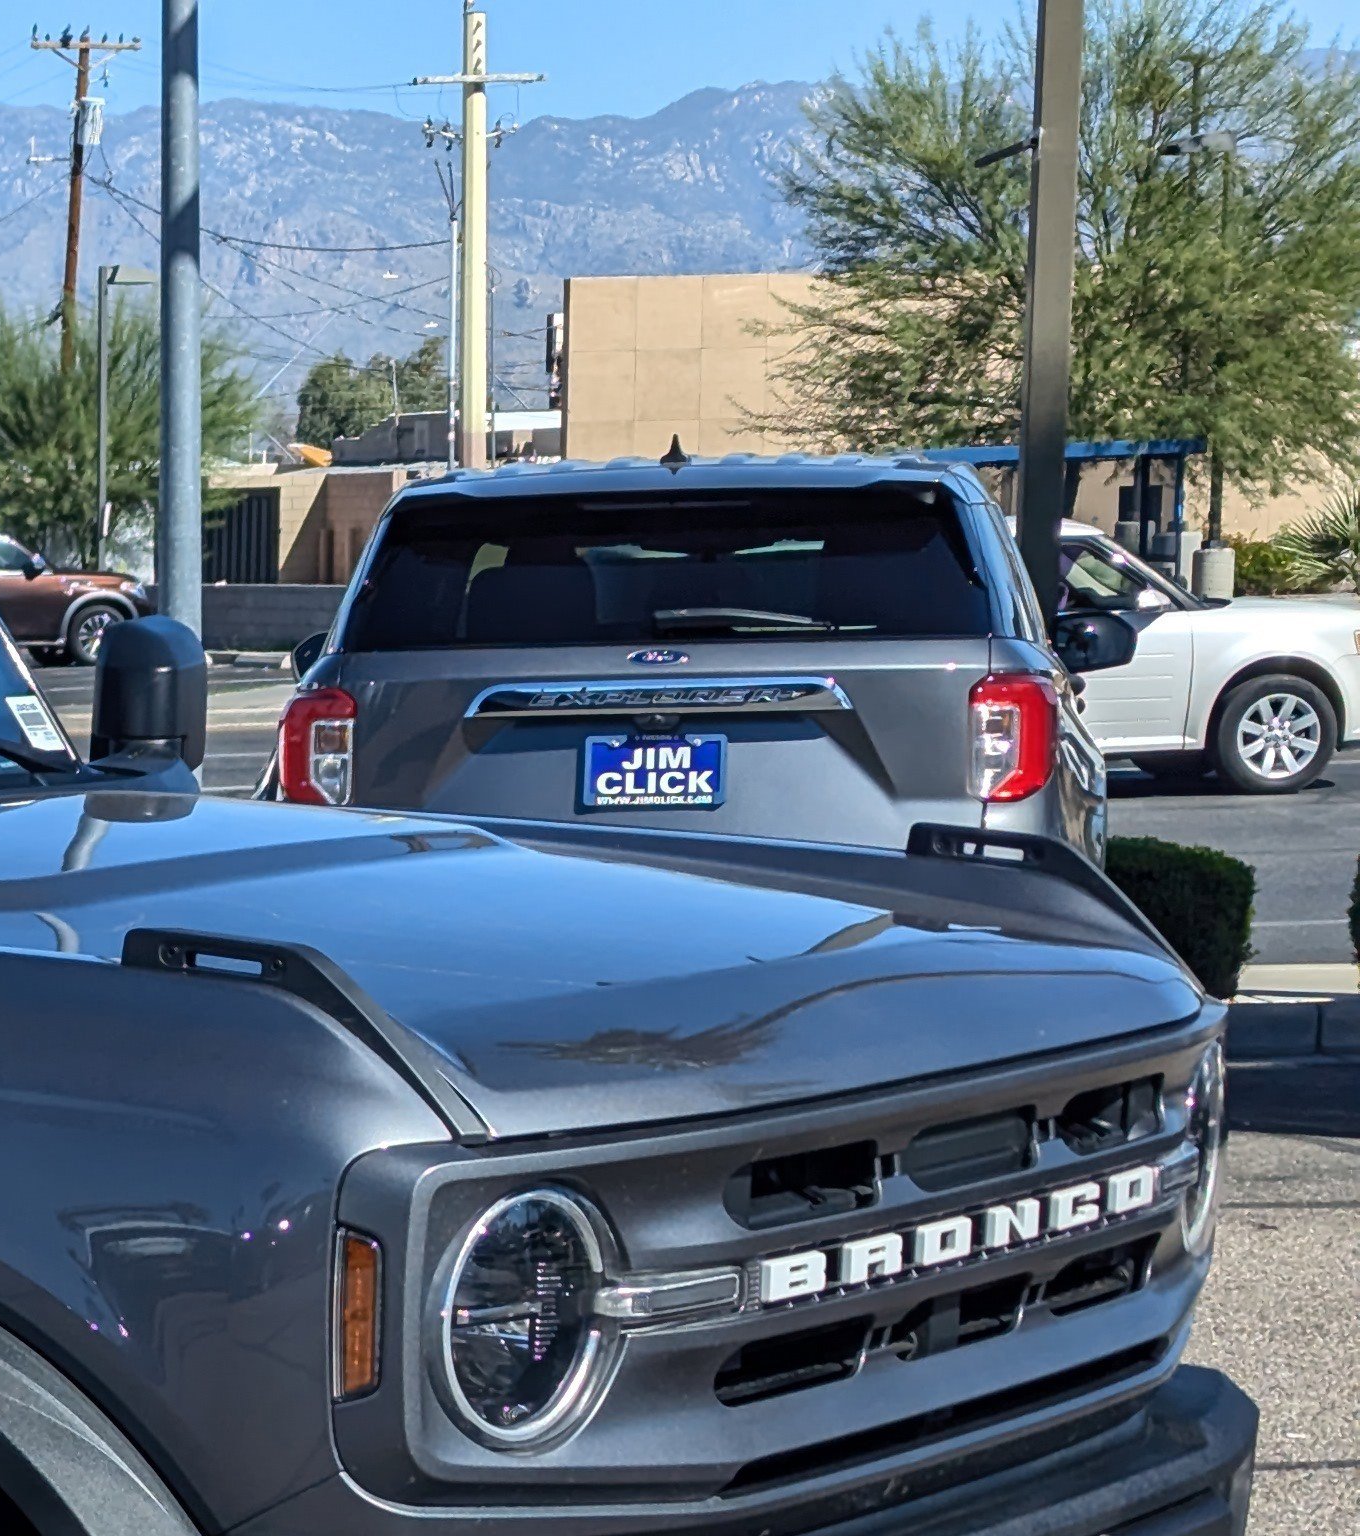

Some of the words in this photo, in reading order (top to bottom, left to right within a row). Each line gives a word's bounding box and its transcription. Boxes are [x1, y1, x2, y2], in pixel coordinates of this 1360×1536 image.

[529, 688, 783, 706] EXPLORER
[621, 746, 691, 770] JIM
[596, 771, 714, 795] CLICK
[760, 1163, 1157, 1305] BRONCO
